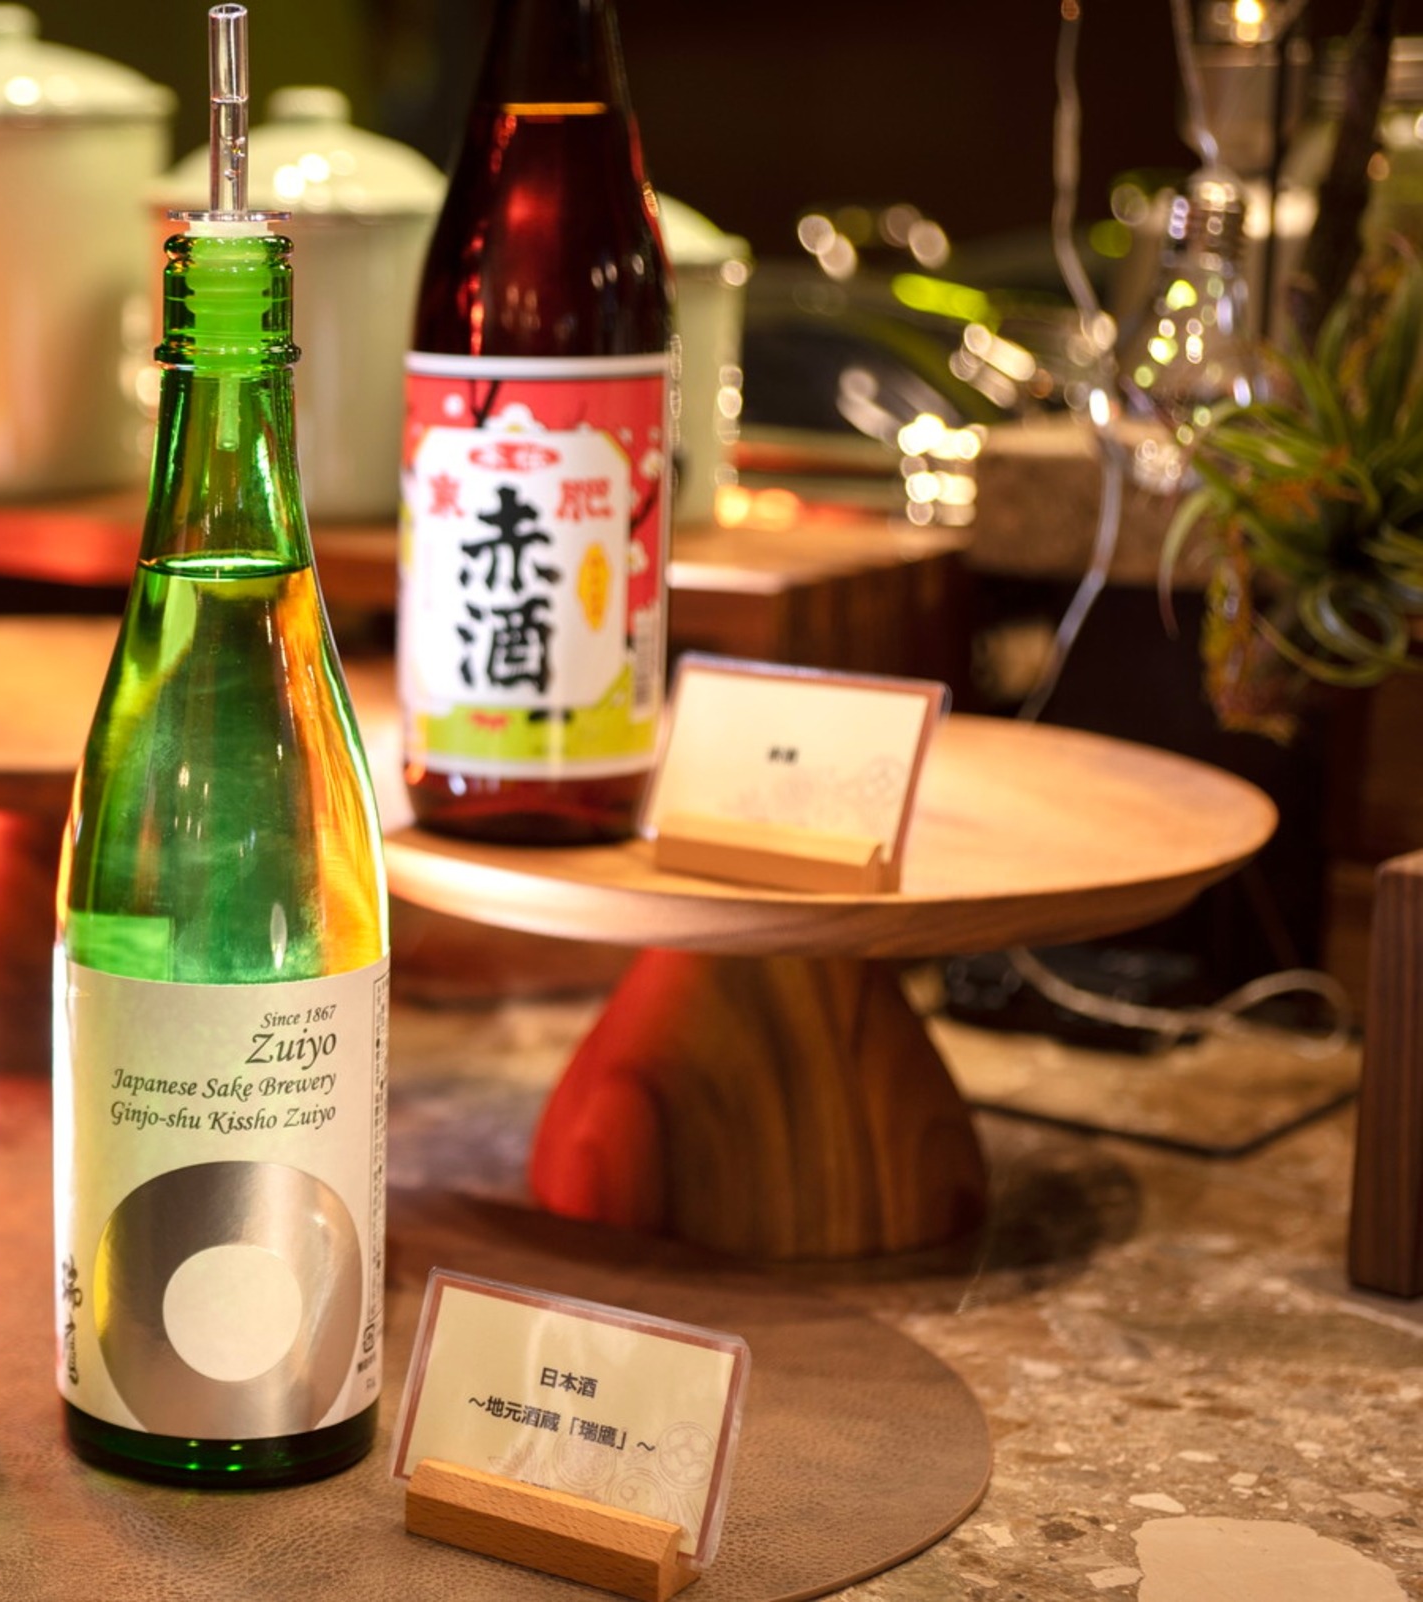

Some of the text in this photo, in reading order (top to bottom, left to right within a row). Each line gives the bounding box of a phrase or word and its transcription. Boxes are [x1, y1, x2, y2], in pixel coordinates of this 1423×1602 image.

[457, 485, 561, 694] 赤酒
[260, 1004, 337, 1029] Since 1867
[244, 1027, 337, 1071] Zuiyo
[111, 1069, 337, 1102] Japanese Sake Brewery
[110, 1101, 337, 1134] Ginjo-shu Kissho Zuiyo
[539, 1366, 598, 1399] 日本酒
